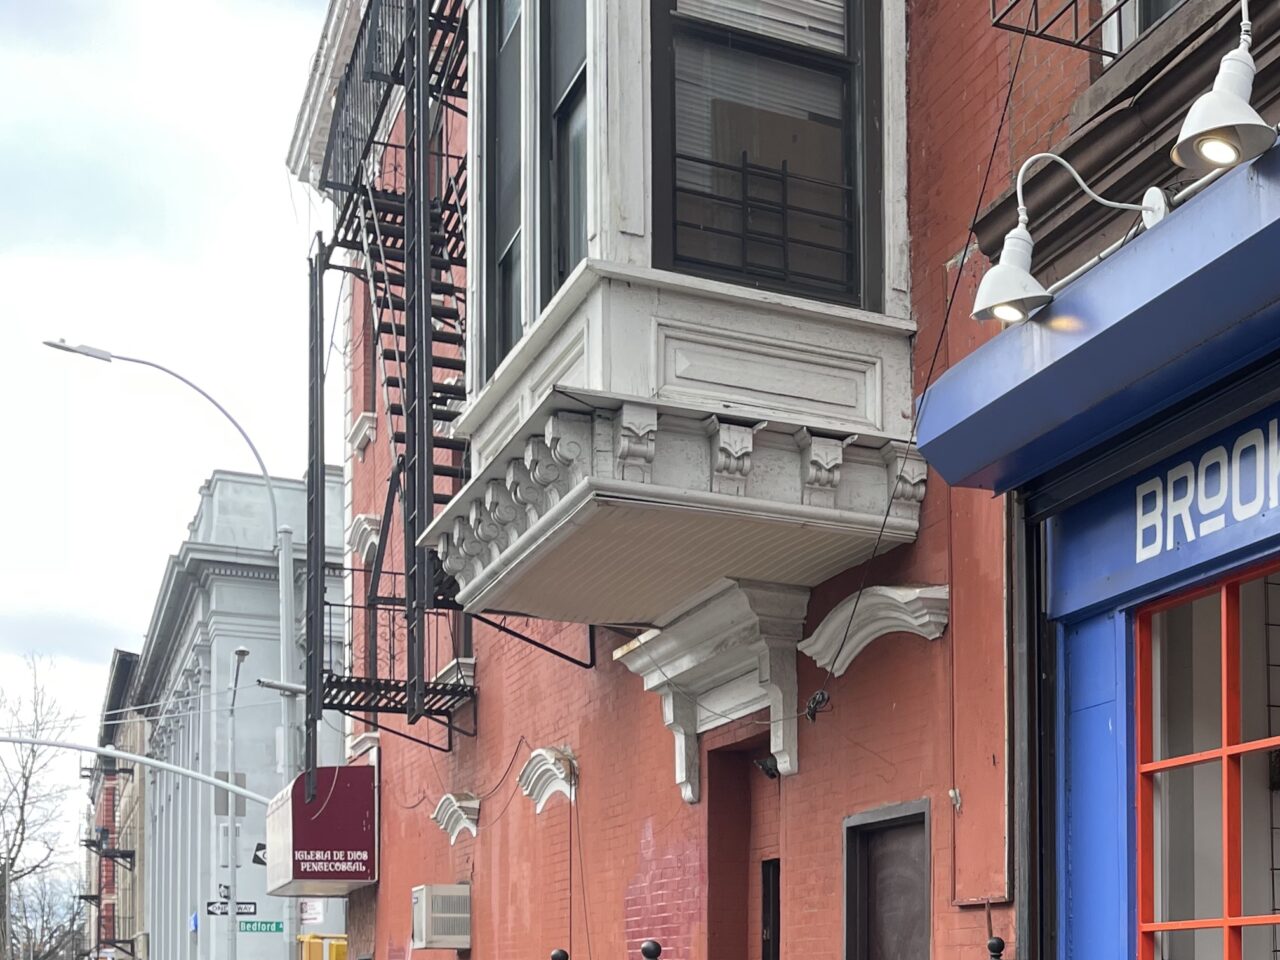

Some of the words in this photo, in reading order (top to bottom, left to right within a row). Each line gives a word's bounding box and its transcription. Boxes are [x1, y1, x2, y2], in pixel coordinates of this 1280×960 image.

[294, 850, 331, 861] IGLESIA
[333, 850, 345, 861] DE
[347, 850, 369, 861] DIOS
[300, 861, 366, 872] PENTECOSTAL
[236, 903, 252, 912] WAY
[240, 921, 276, 932] Bedford
